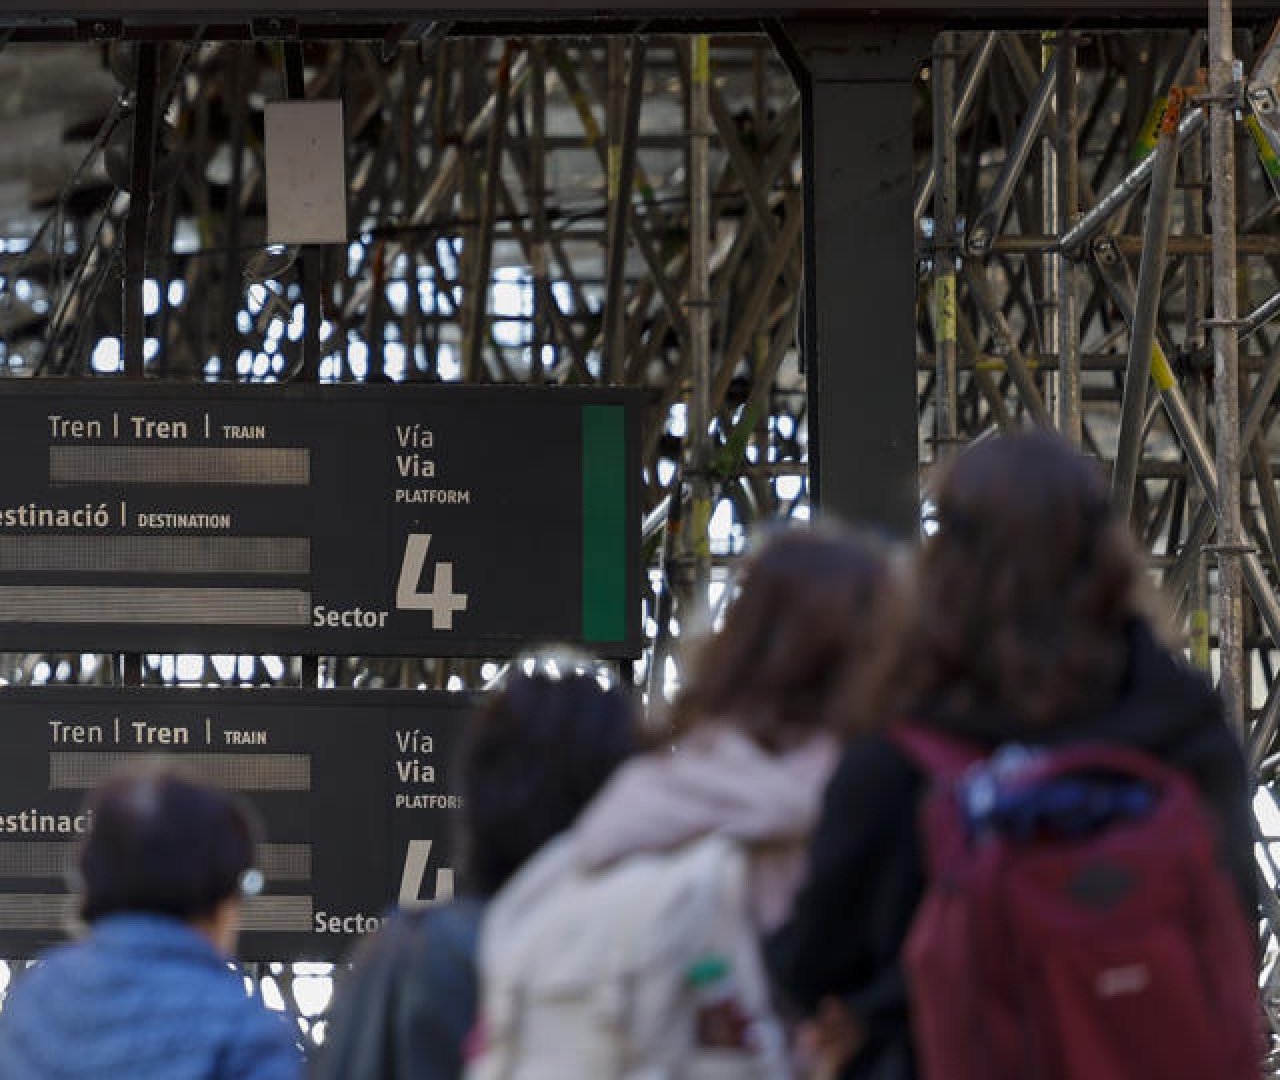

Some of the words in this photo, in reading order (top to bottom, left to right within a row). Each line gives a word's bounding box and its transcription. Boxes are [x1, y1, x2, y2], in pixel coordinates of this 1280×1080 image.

[48, 416, 100, 438] Tren
[132, 418, 186, 438] Tren
[224, 426, 264, 438] TRAIN
[397, 424, 432, 448] Vía
[396, 454, 434, 476] Via
[396, 490, 468, 504] PLATFORM
[138, 514, 230, 528] DESTINATION
[314, 606, 388, 626] Sector
[396, 534, 468, 630] 4
[50, 722, 102, 742] Tren
[132, 722, 188, 744] Tren
[224, 732, 266, 744] TRAIN
[396, 730, 432, 752] Vía
[396, 760, 434, 782] Via
